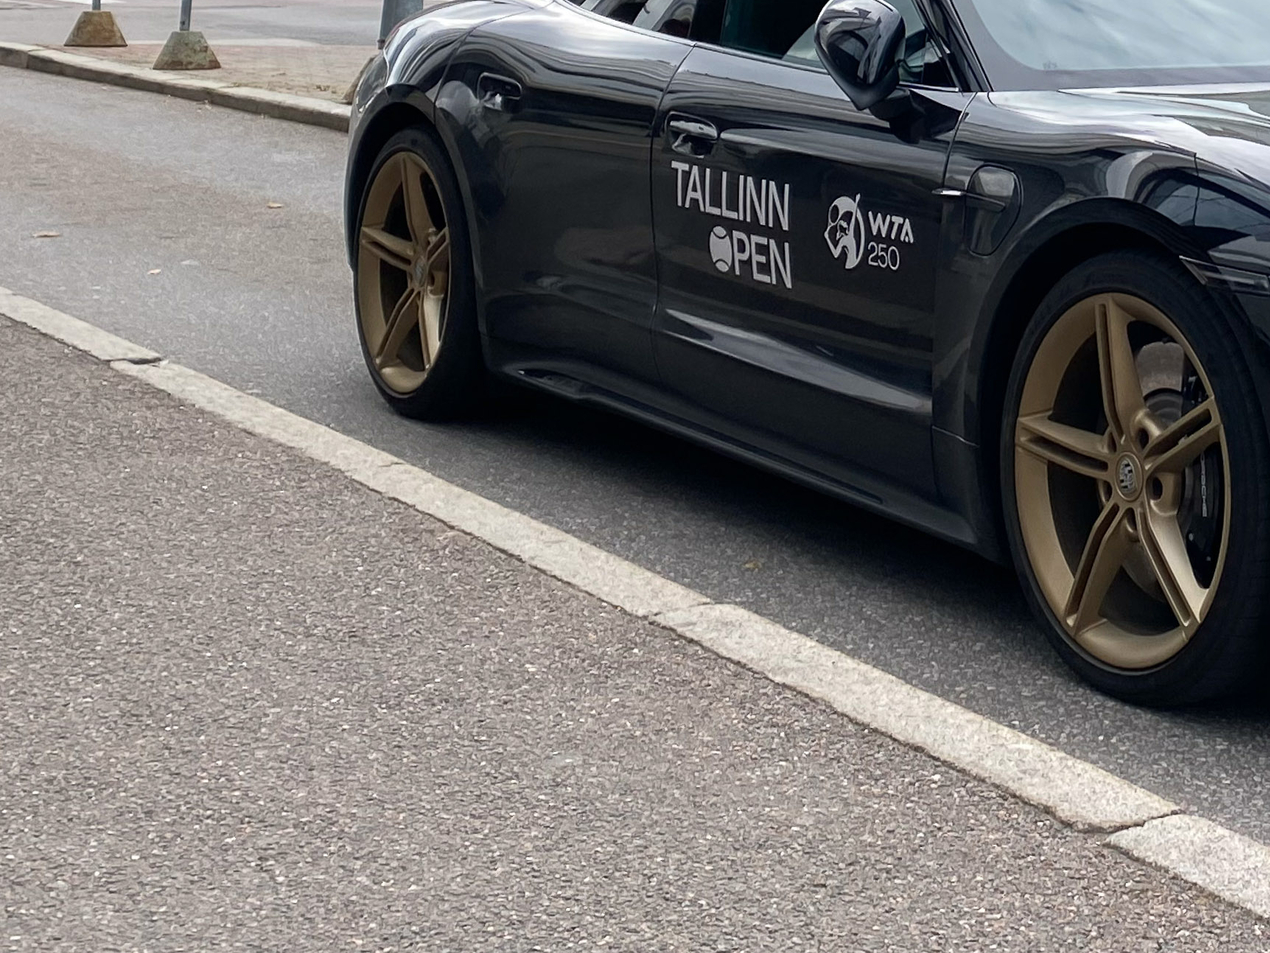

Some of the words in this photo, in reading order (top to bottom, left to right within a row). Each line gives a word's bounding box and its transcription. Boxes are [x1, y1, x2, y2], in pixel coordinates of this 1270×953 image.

[671, 160, 790, 232] TALLINN
[868, 210, 914, 244] WTA
[868, 241, 900, 271] 250
